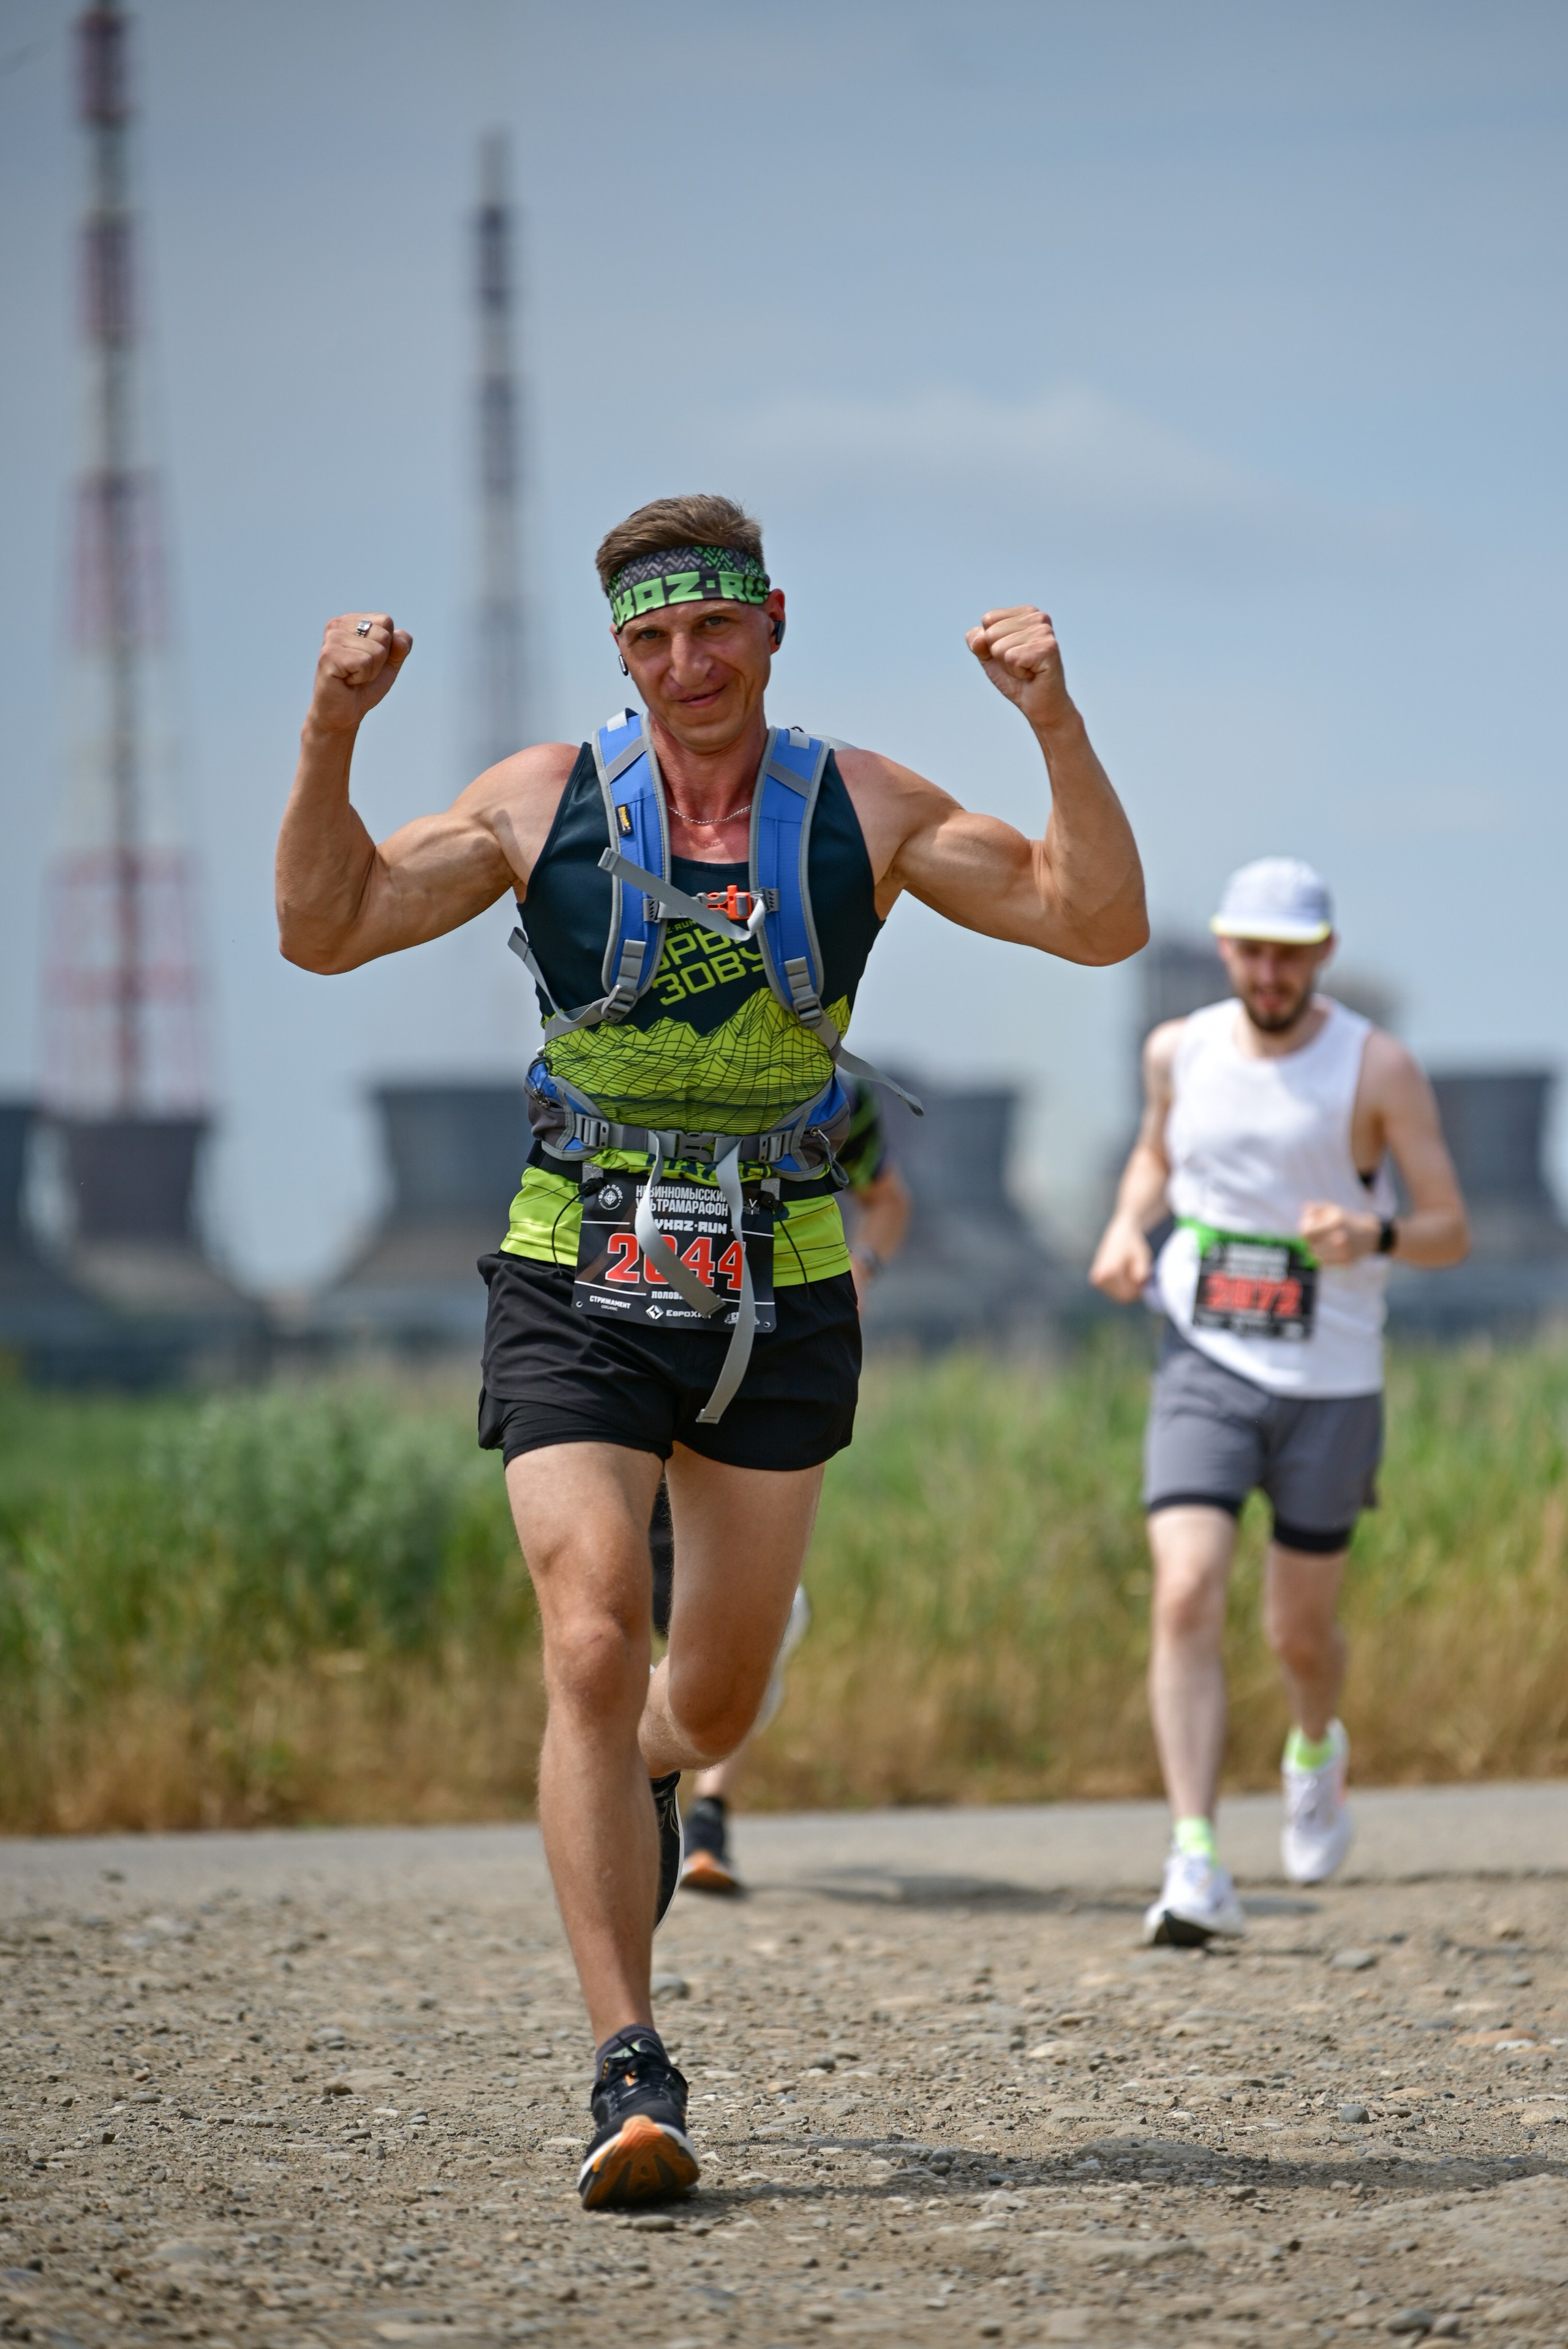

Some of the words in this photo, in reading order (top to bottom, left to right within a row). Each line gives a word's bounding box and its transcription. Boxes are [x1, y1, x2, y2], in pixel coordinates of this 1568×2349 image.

[652, 947, 764, 1006] ЗОВУ
[636, 1185, 726, 1203] НВИННОМЫССКИ
[635, 1198, 728, 1217] ЬТРАМАРАФОН
